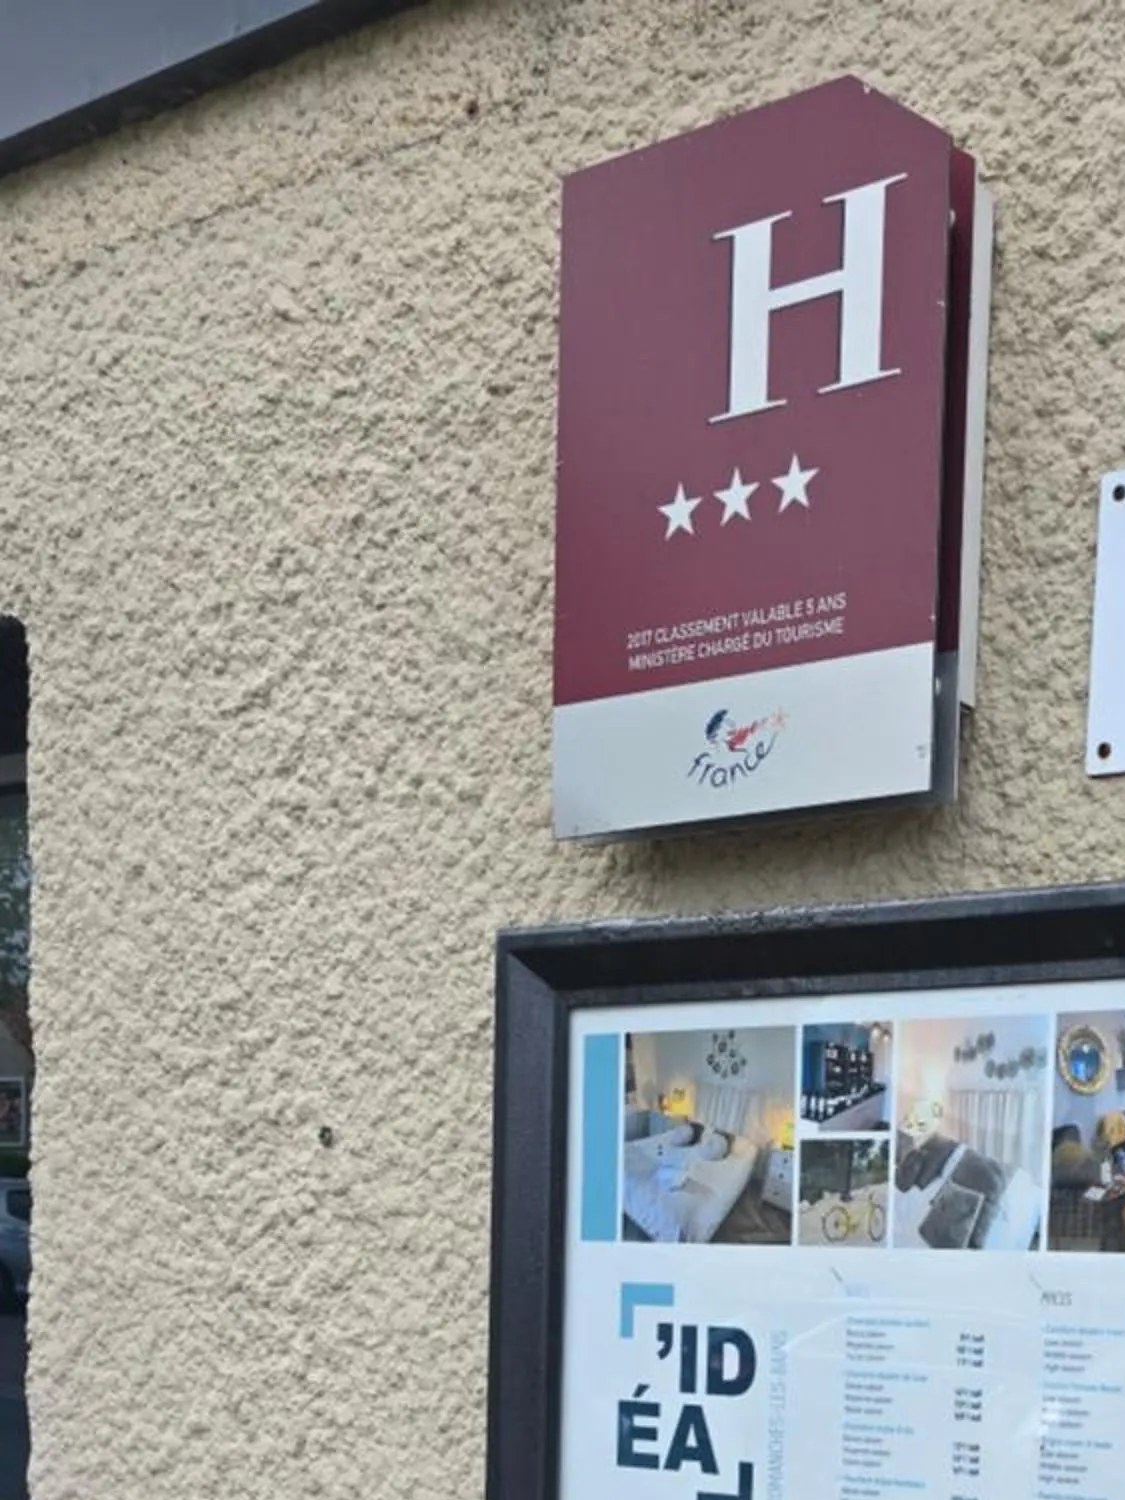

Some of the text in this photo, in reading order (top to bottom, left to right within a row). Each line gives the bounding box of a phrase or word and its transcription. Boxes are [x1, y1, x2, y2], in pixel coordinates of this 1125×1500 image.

[707, 172, 908, 424] H
[628, 616, 845, 672] MINISTÈRE CHARGÉ DU TOURISME
[654, 612, 740, 645] CLASSEMENT
[741, 600, 803, 628] VALABLE
[805, 598, 815, 615] 5
[816, 591, 847, 613] ANS
